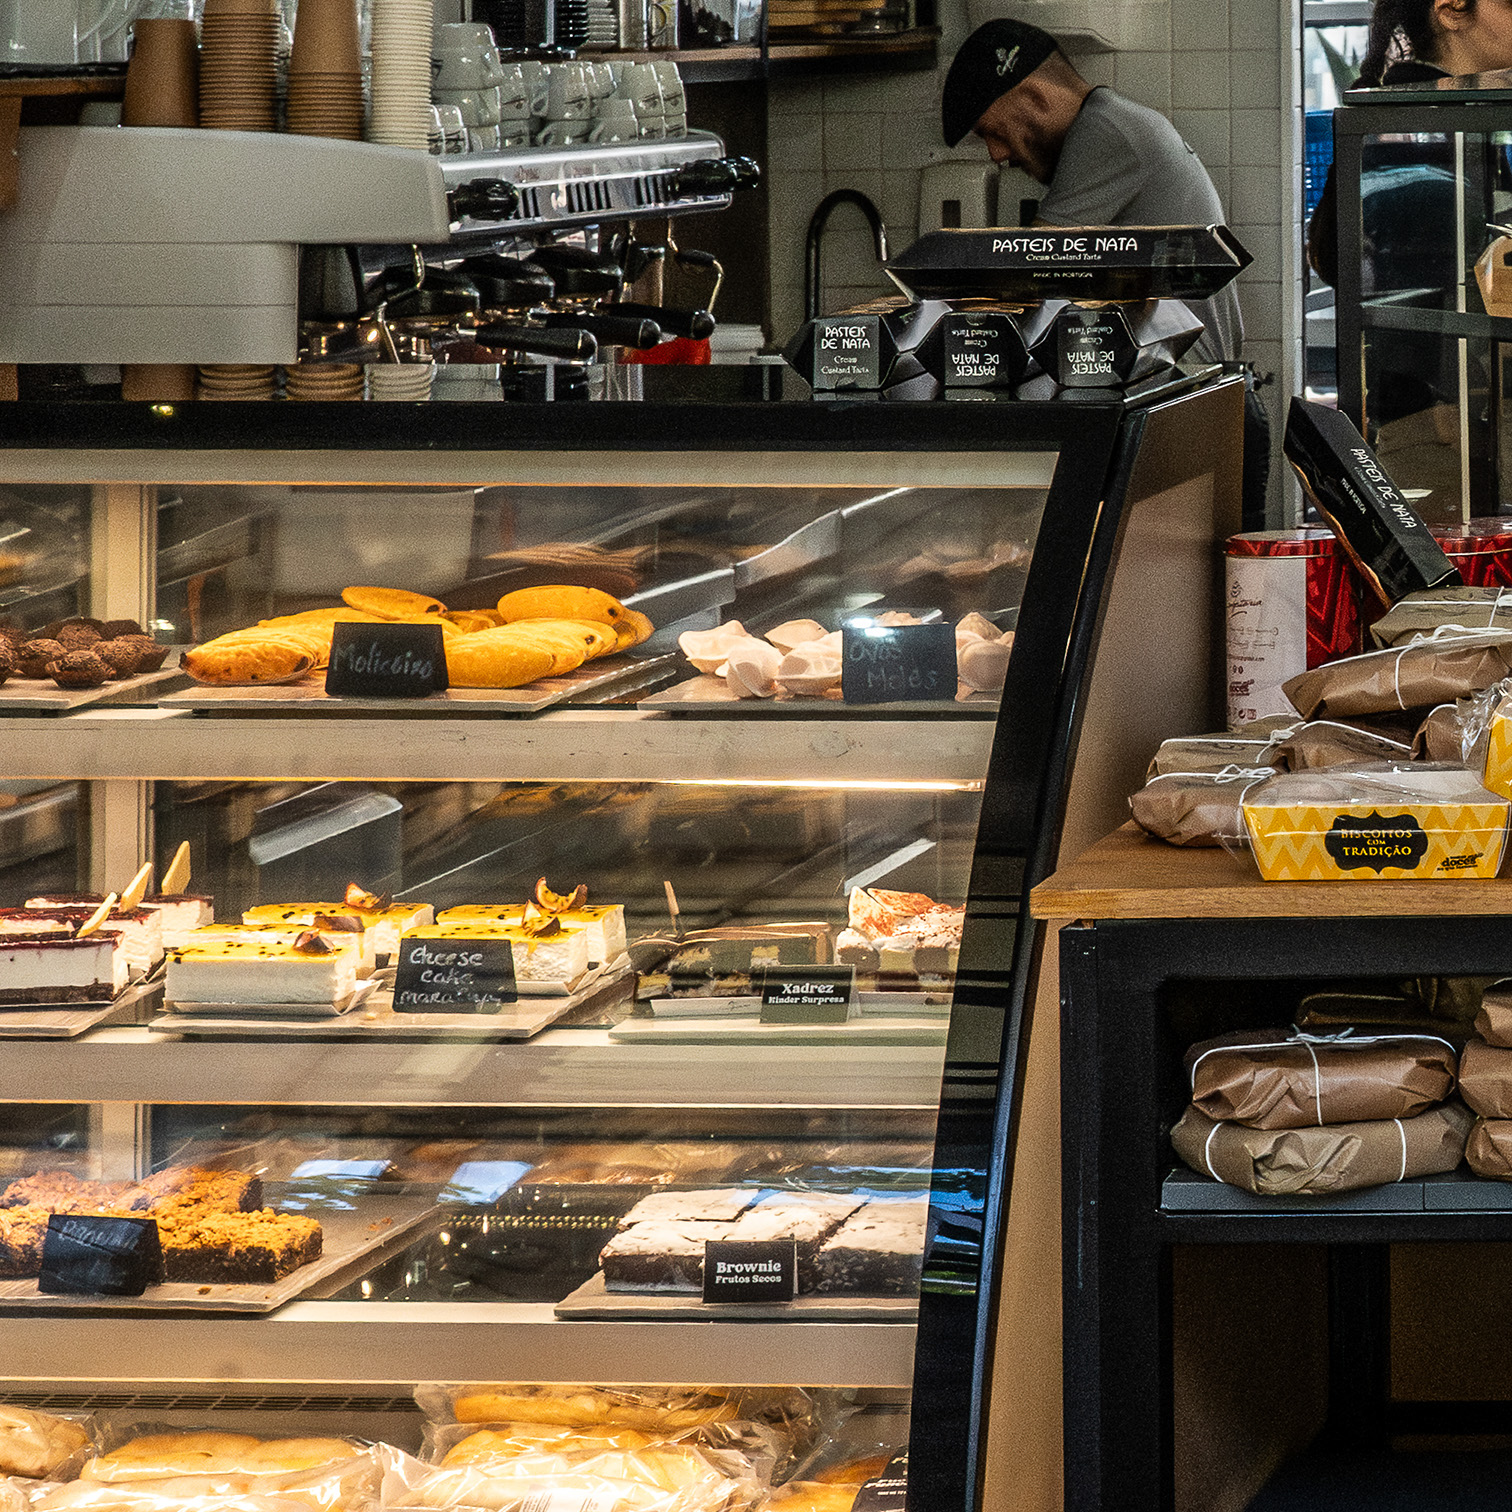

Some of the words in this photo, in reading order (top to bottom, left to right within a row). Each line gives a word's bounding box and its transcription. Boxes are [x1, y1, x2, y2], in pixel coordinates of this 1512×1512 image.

[993, 238, 1056, 252] PASTEIS
[1063, 238, 1087, 252] DE
[1095, 238, 1138, 251] NATA
[826, 326, 866, 337] PASTEIS
[822, 339, 837, 349] DE
[843, 338, 870, 349] NATA
[952, 354, 979, 364] NATA
[984, 354, 999, 364] DE
[1067, 352, 1095, 362] NATA
[1100, 351, 1114, 361] DE
[956, 366, 996, 376] PASTEIS
[1071, 363, 1112, 375] PASTEIS
[1351, 449, 1387, 483] PASTEIS
[1377, 486, 1398, 500] DE
[1390, 504, 1417, 527] NATA
[1341, 829, 1412, 838] BISCOITOS
[1343, 845, 1411, 857] TRADIÇÃO
[782, 983, 834, 994] Xadrez
[801, 996, 844, 1005] Surpresa
[716, 1260, 781, 1273] Brownie
[752, 1275, 781, 1283] Secos
